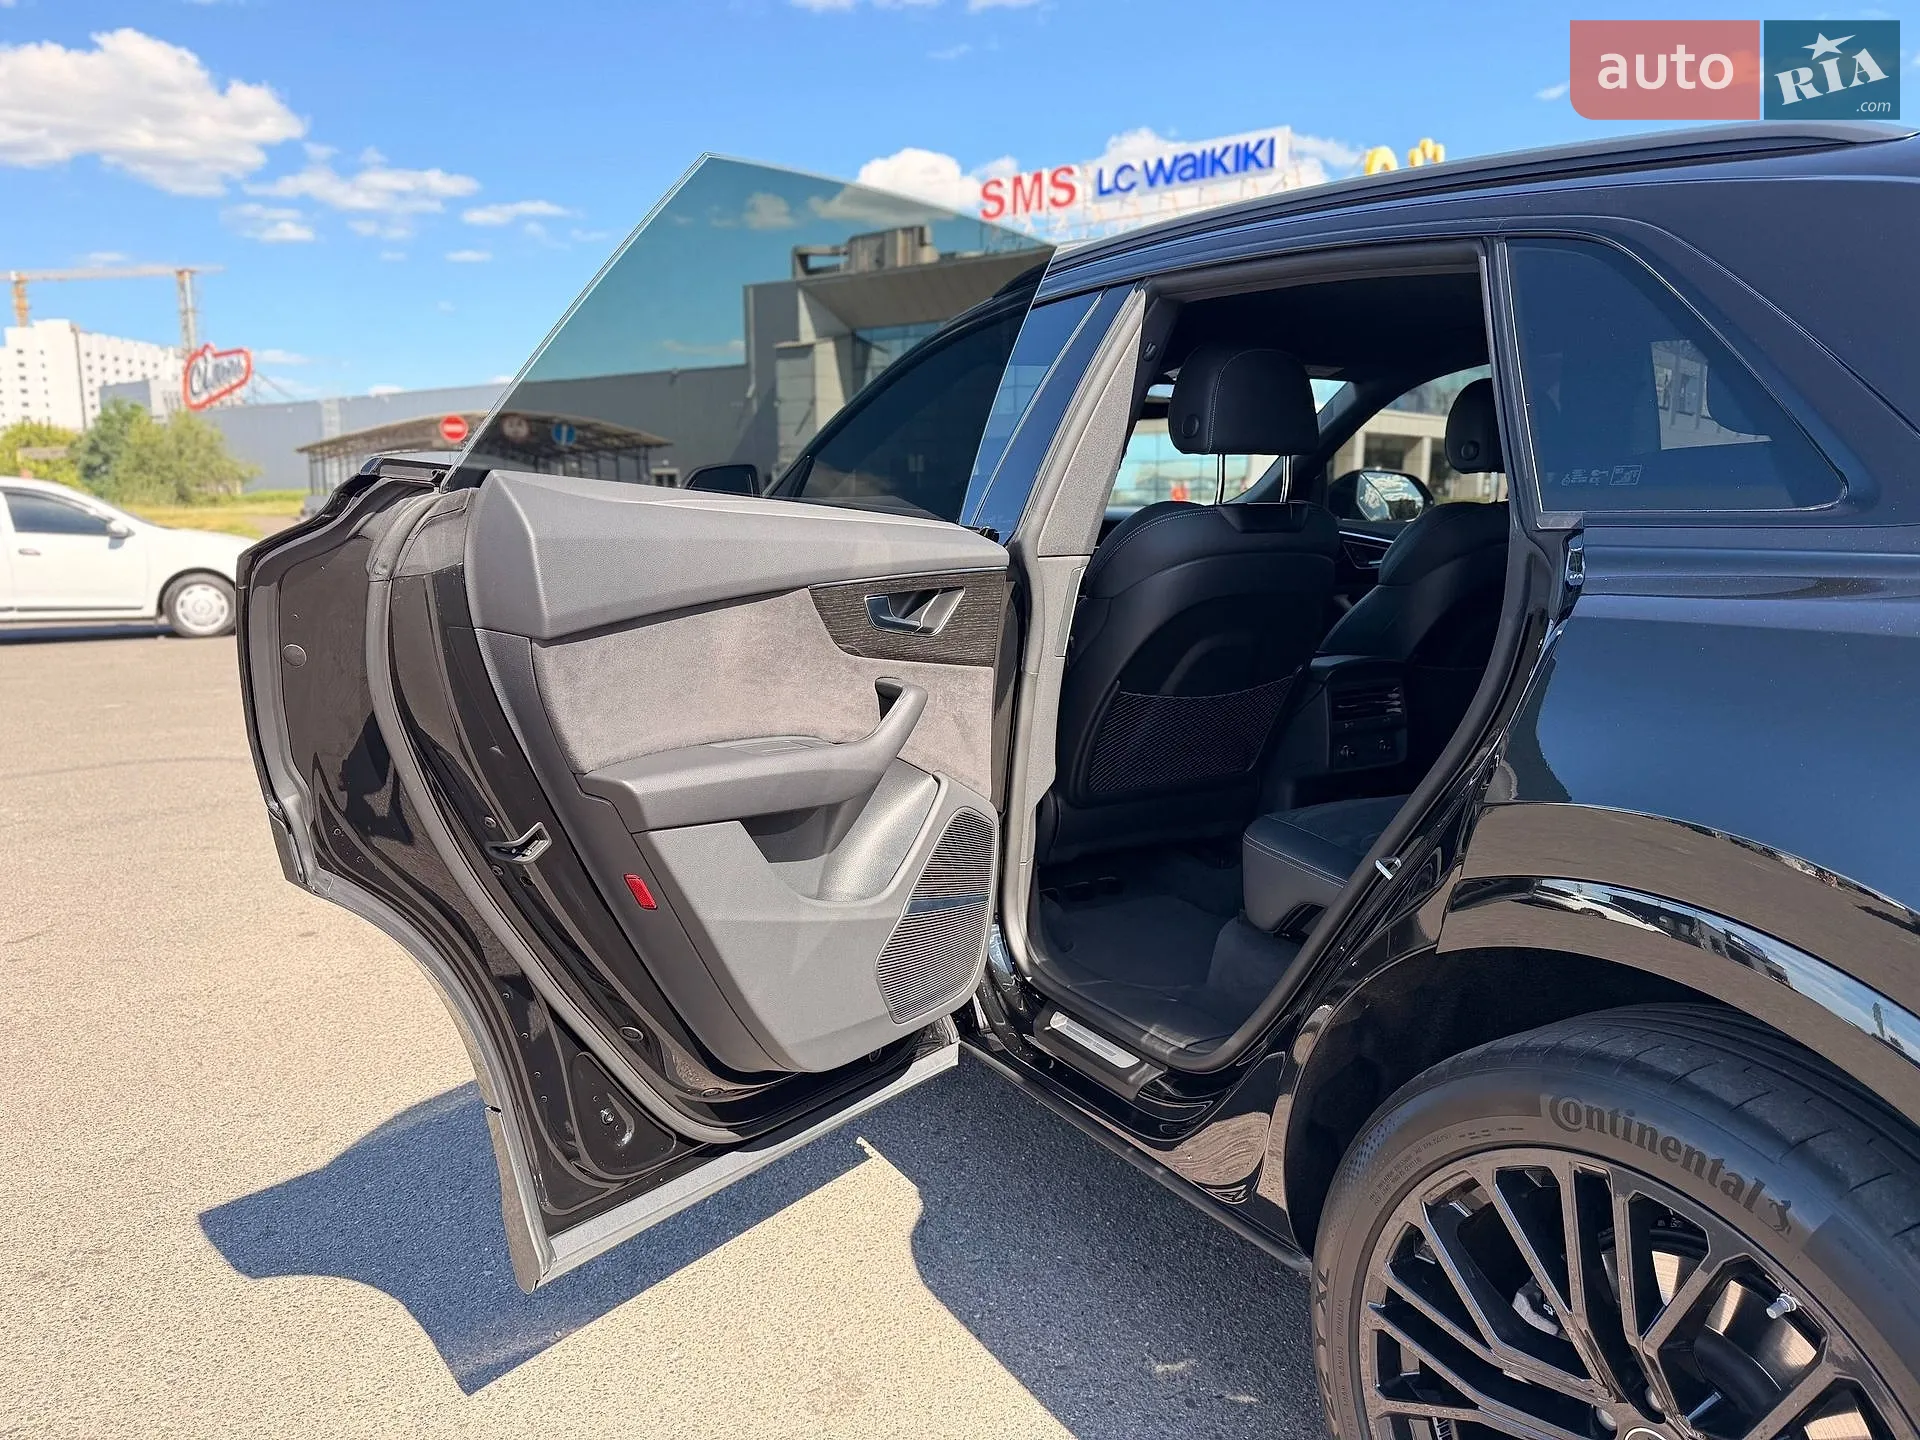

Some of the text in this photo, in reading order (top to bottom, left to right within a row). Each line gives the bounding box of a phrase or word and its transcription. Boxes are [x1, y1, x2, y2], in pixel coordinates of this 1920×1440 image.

[980, 166, 1078, 220] SMS
[1097, 164, 1138, 197] LC
[1550, 1094, 1767, 1214] Continental
